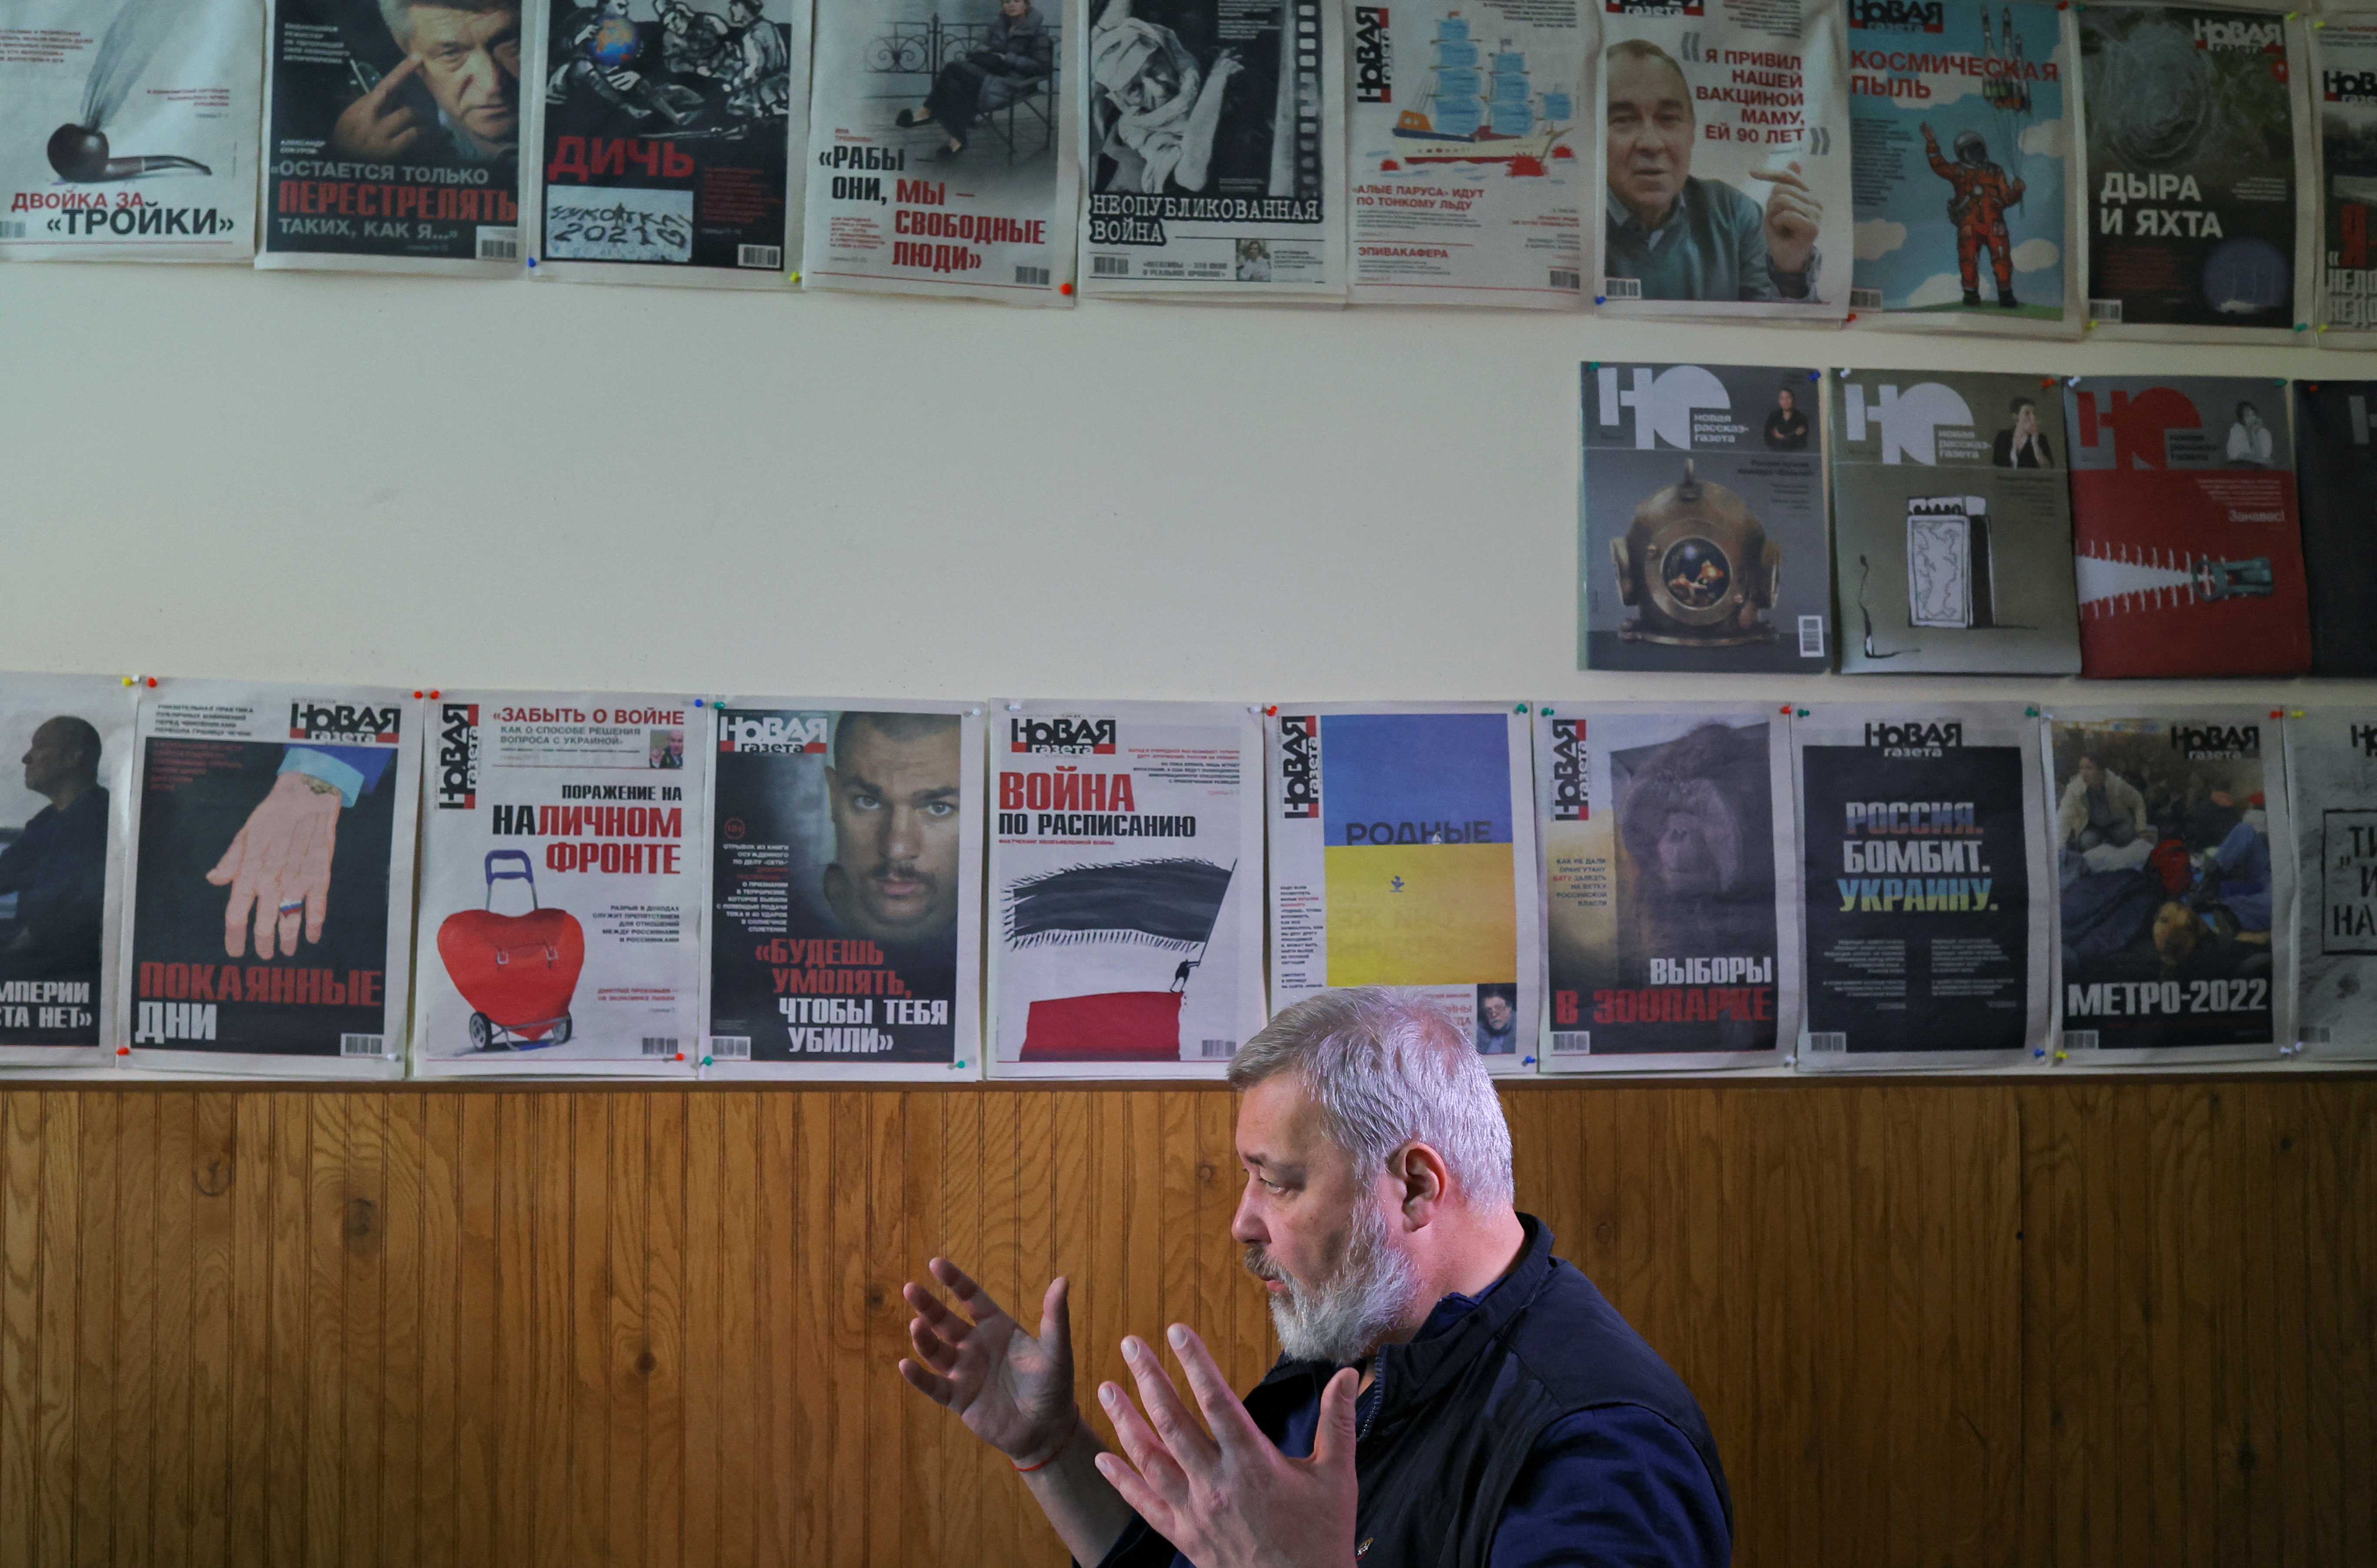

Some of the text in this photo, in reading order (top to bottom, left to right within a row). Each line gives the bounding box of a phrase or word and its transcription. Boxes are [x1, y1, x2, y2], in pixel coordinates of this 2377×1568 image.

[2194, 18, 2282, 51] НОВАЯ
[1355, 6, 1390, 103] НОВАЯ
[1706, 49, 1801, 70] Я ПРИВИЛ
[1850, 49, 2058, 82] КОСМИЧЕСКАЯ
[1732, 68, 1803, 88] НАШЕЙ
[1851, 75, 1931, 99] ПЫЛЬ
[2323, 70, 2377, 101] НОВ
[1697, 85, 1804, 107] ВАКЦИНОЙ
[1741, 108, 1805, 126] МАМУ,
[1705, 123, 1805, 144] ЕЙ 90 ЛЕТ
[270, 160, 488, 184] «ОСТАЕТСЯ ТОЛЬКО
[548, 136, 694, 182] ДИЧЬ
[818, 145, 905, 171] «РАБЫ
[11, 190, 144, 213] ДВОЙКА ЗА
[278, 181, 517, 222] ПЕРЕСТРЕЛЯТЬ
[832, 176, 945, 205] ОНИ, МЫ
[1353, 185, 1485, 200] «АЛЫЕ ПАРУСА» ИДУТ
[2100, 172, 2202, 204] ДЫРА
[47, 202, 234, 235] «ТРОЙКИ»
[1090, 193, 1320, 221] НЕОПУБЛИКОВАННАЯ
[1357, 196, 1472, 212] ПО ТОНКОМУ ЛЬДУ
[279, 218, 356, 237] ТАКИХ,
[364, 222, 409, 238] КАК
[895, 210, 1046, 244] СВОБОДНЫЕ
[1091, 218, 1164, 243] ВОЙНА
[2100, 208, 2223, 239] И ЯХТА
[892, 241, 982, 273] ЛЮДИ»
[1358, 246, 1449, 259] ЭПИВАКАФЕРА
[291, 702, 401, 740] НОВАЯ
[493, 707, 684, 725] «ЗАБЫТЬ О ВОЙНЕ
[310, 729, 377, 743] газета
[500, 736, 550, 744] ВОПРОСА
[589, 727, 641, 736] РЕШЕНИЯ
[720, 716, 827, 752] НОВАЯ
[1011, 718, 1116, 752] НОВАЯ
[1865, 722, 1962, 748] НОВАЯ
[2171, 725, 2259, 759] НОВАЯ
[439, 704, 475, 809] НОВАЯ
[740, 742, 804, 753] газета
[1031, 744, 1095, 755] газета
[1884, 747, 1943, 758] газета
[2189, 749, 2242, 759] газета
[1281, 716, 1319, 818] НОВАЯ
[1552, 719, 1588, 820] НОВАЯ
[562, 785, 682, 801] ПОРАЖЕНИЕ НА
[999, 766, 1135, 812] ВОЙНА
[492, 805, 682, 838] НАЛИЧНОМ
[998, 814, 1196, 837] ПО РАСПИСАНИЮ
[1346, 820, 1492, 846] РОДНЫЕ
[1845, 802, 1984, 835] РОССИЯ.
[546, 842, 680, 874] ФРОНТЕ
[1843, 840, 1990, 873] БОМБИТ.
[1837, 878, 1998, 912] УКРАИНУ.
[756, 938, 884, 968] «БУДЕШЬ
[139, 962, 382, 1006] ПОКАЯННЫЕ
[772, 968, 912, 999] УМОЛЯТЬ,
[1650, 956, 1772, 985] ВЫБОРЫ
[779, 998, 873, 1025] ЧТОБЫ
[883, 999, 948, 1025] ТЕБЯ
[1556, 987, 1772, 1024] В ЗООПАРКЕ
[2068, 978, 2267, 1016] МЕТРО-2022
[0, 1006, 92, 1029] ТА НЕТ»
[135, 1001, 217, 1044] ДНИ
[788, 1027, 894, 1053] УБИЛИ»
